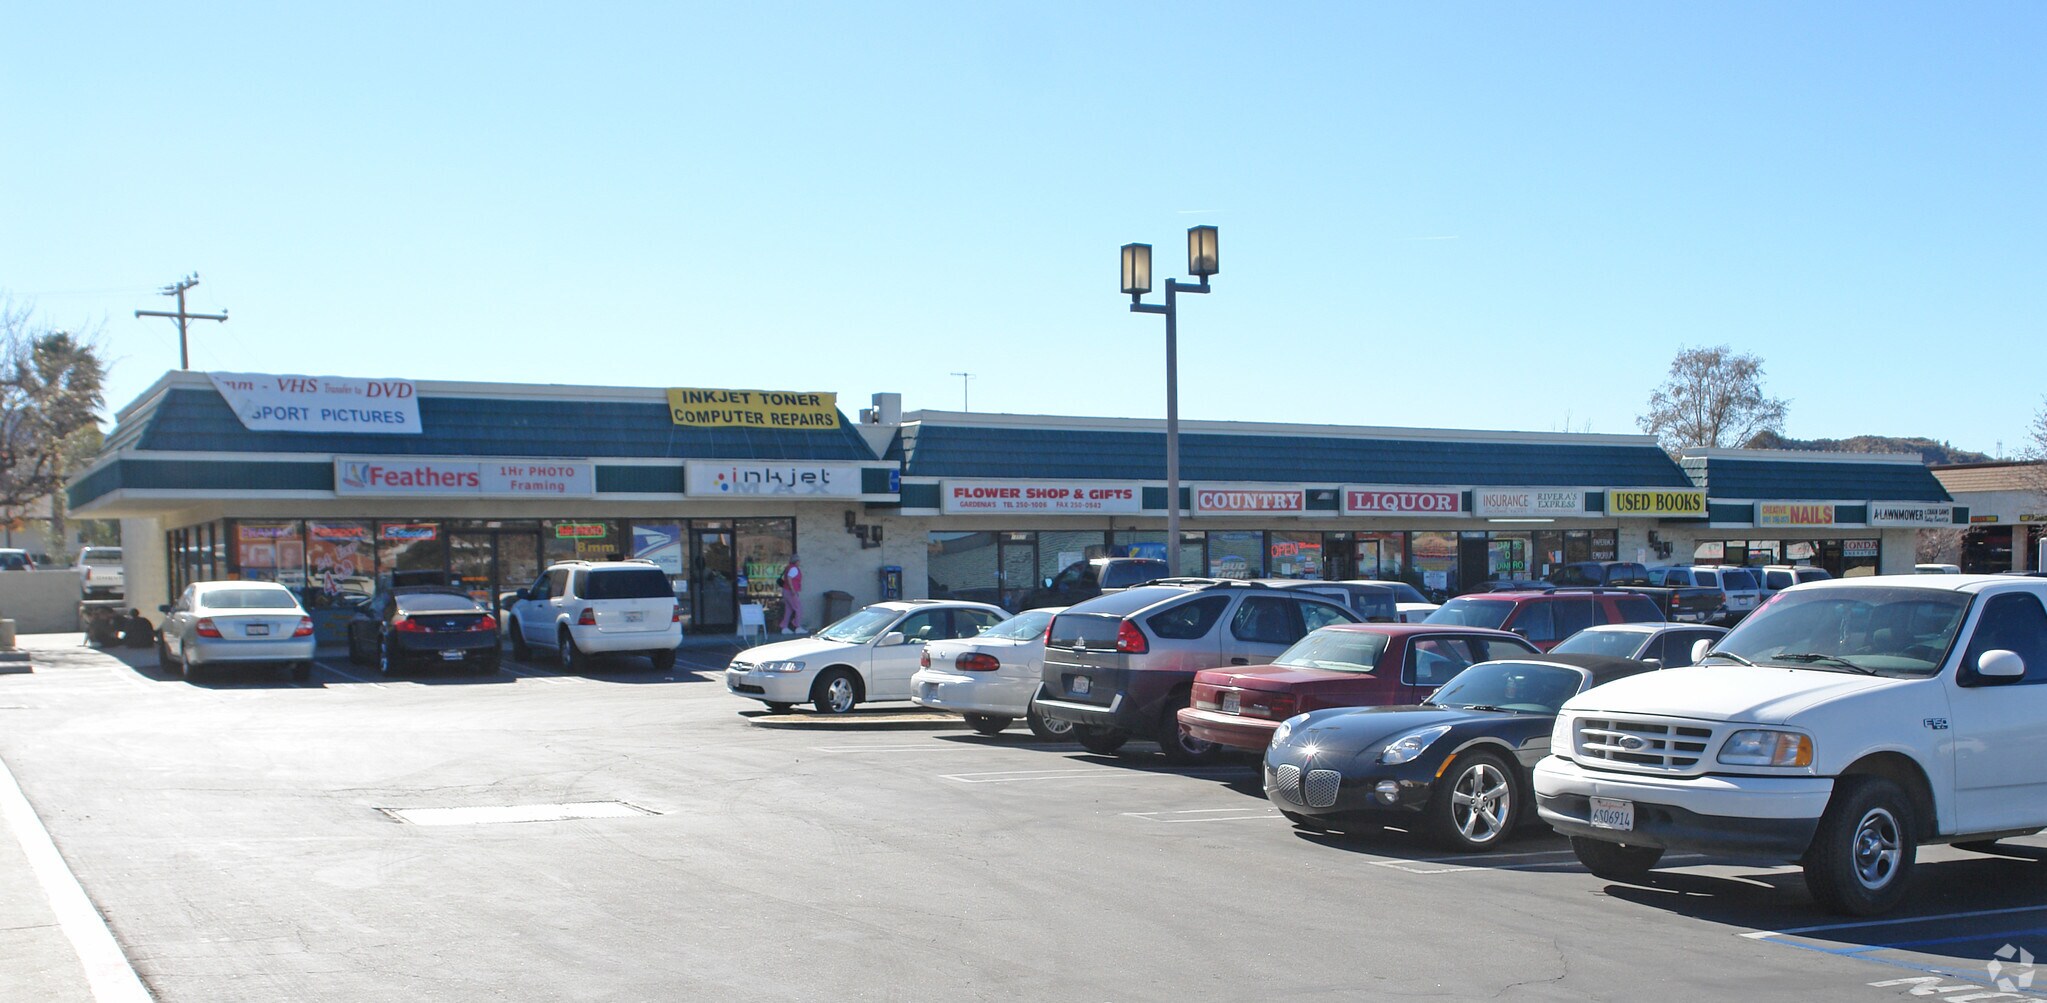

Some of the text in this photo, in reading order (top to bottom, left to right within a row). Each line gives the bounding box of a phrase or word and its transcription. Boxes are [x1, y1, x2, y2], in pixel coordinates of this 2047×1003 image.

[277, 378, 319, 393] VHS
[366, 381, 413, 398] DVD
[682, 390, 821, 407] INKJET TONER
[321, 408, 406, 424] PICTURES
[674, 408, 834, 427] COMPUTER REPAIRS
[369, 466, 479, 487] Feathers
[500, 466, 576, 477] 1Hr PHOTO
[732, 467, 831, 487] inkjet
[510, 479, 566, 493] Framing
[732, 482, 831, 495] MAX
[953, 487, 1133, 500] FLOWER SHOP & GIFTS
[1199, 491, 1300, 509] COUNTRY
[1354, 493, 1453, 511] LIQUOR
[1483, 494, 1529, 508] INSURANCE
[1537, 492, 1578, 501] RIVERA'S
[1537, 500, 1577, 508] EXPRESS
[1616, 493, 1701, 512] USED BOOKS
[1790, 505, 1834, 525] NAILS
[1271, 542, 1299, 558] OPEN
[1222, 562, 1247, 571] BUD
